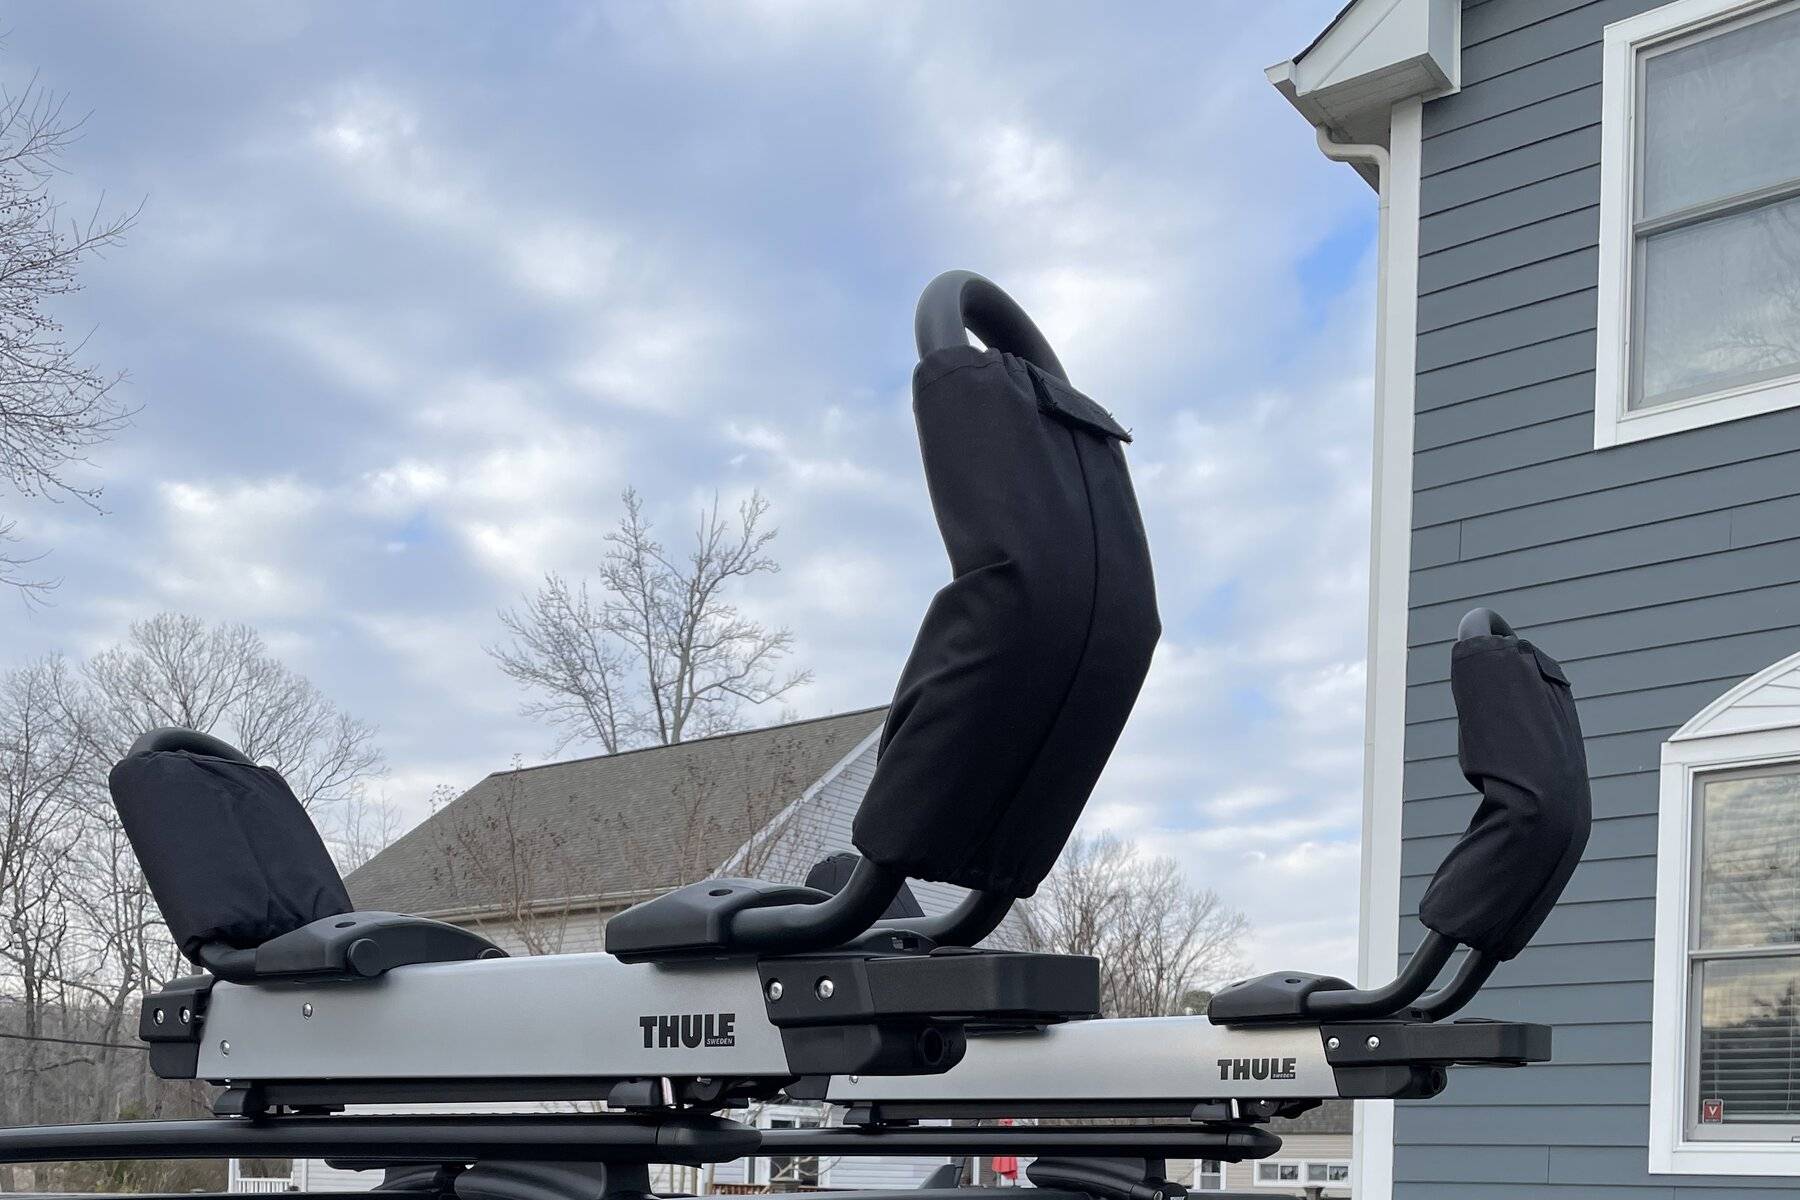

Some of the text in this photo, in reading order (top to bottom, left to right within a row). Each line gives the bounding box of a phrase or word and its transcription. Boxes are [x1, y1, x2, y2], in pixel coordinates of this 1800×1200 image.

[640, 1013, 735, 1048] THULE
[706, 1037, 733, 1045] SWEDEN
[1217, 1058, 1297, 1080] THULE
